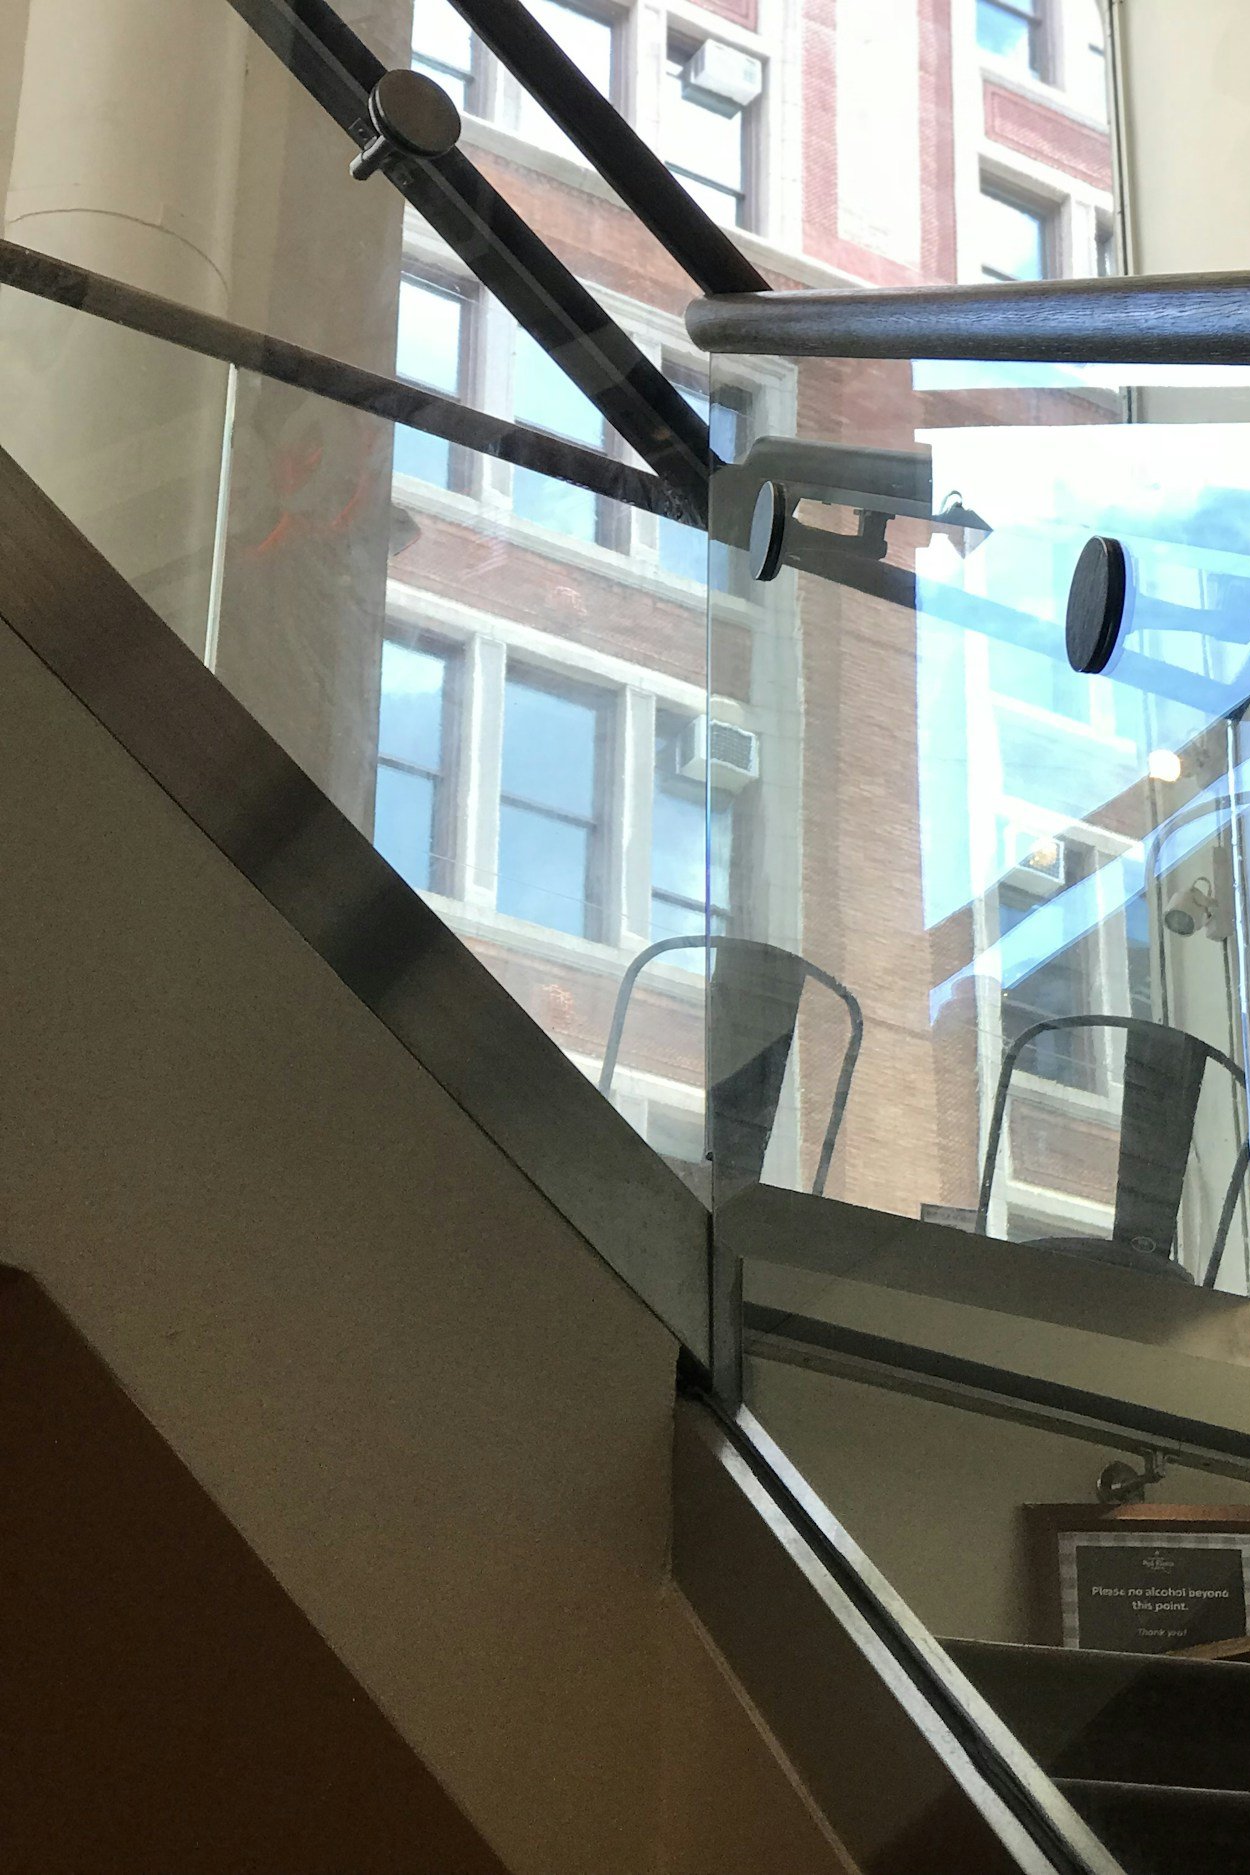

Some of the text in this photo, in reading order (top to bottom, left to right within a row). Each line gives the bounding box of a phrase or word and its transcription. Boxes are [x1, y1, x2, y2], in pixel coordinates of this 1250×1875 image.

[1091, 1586, 1229, 1600] Please no alcohol beyond
[1132, 1600, 1189, 1613] this point.
[1137, 1627, 1165, 1637] Thank
